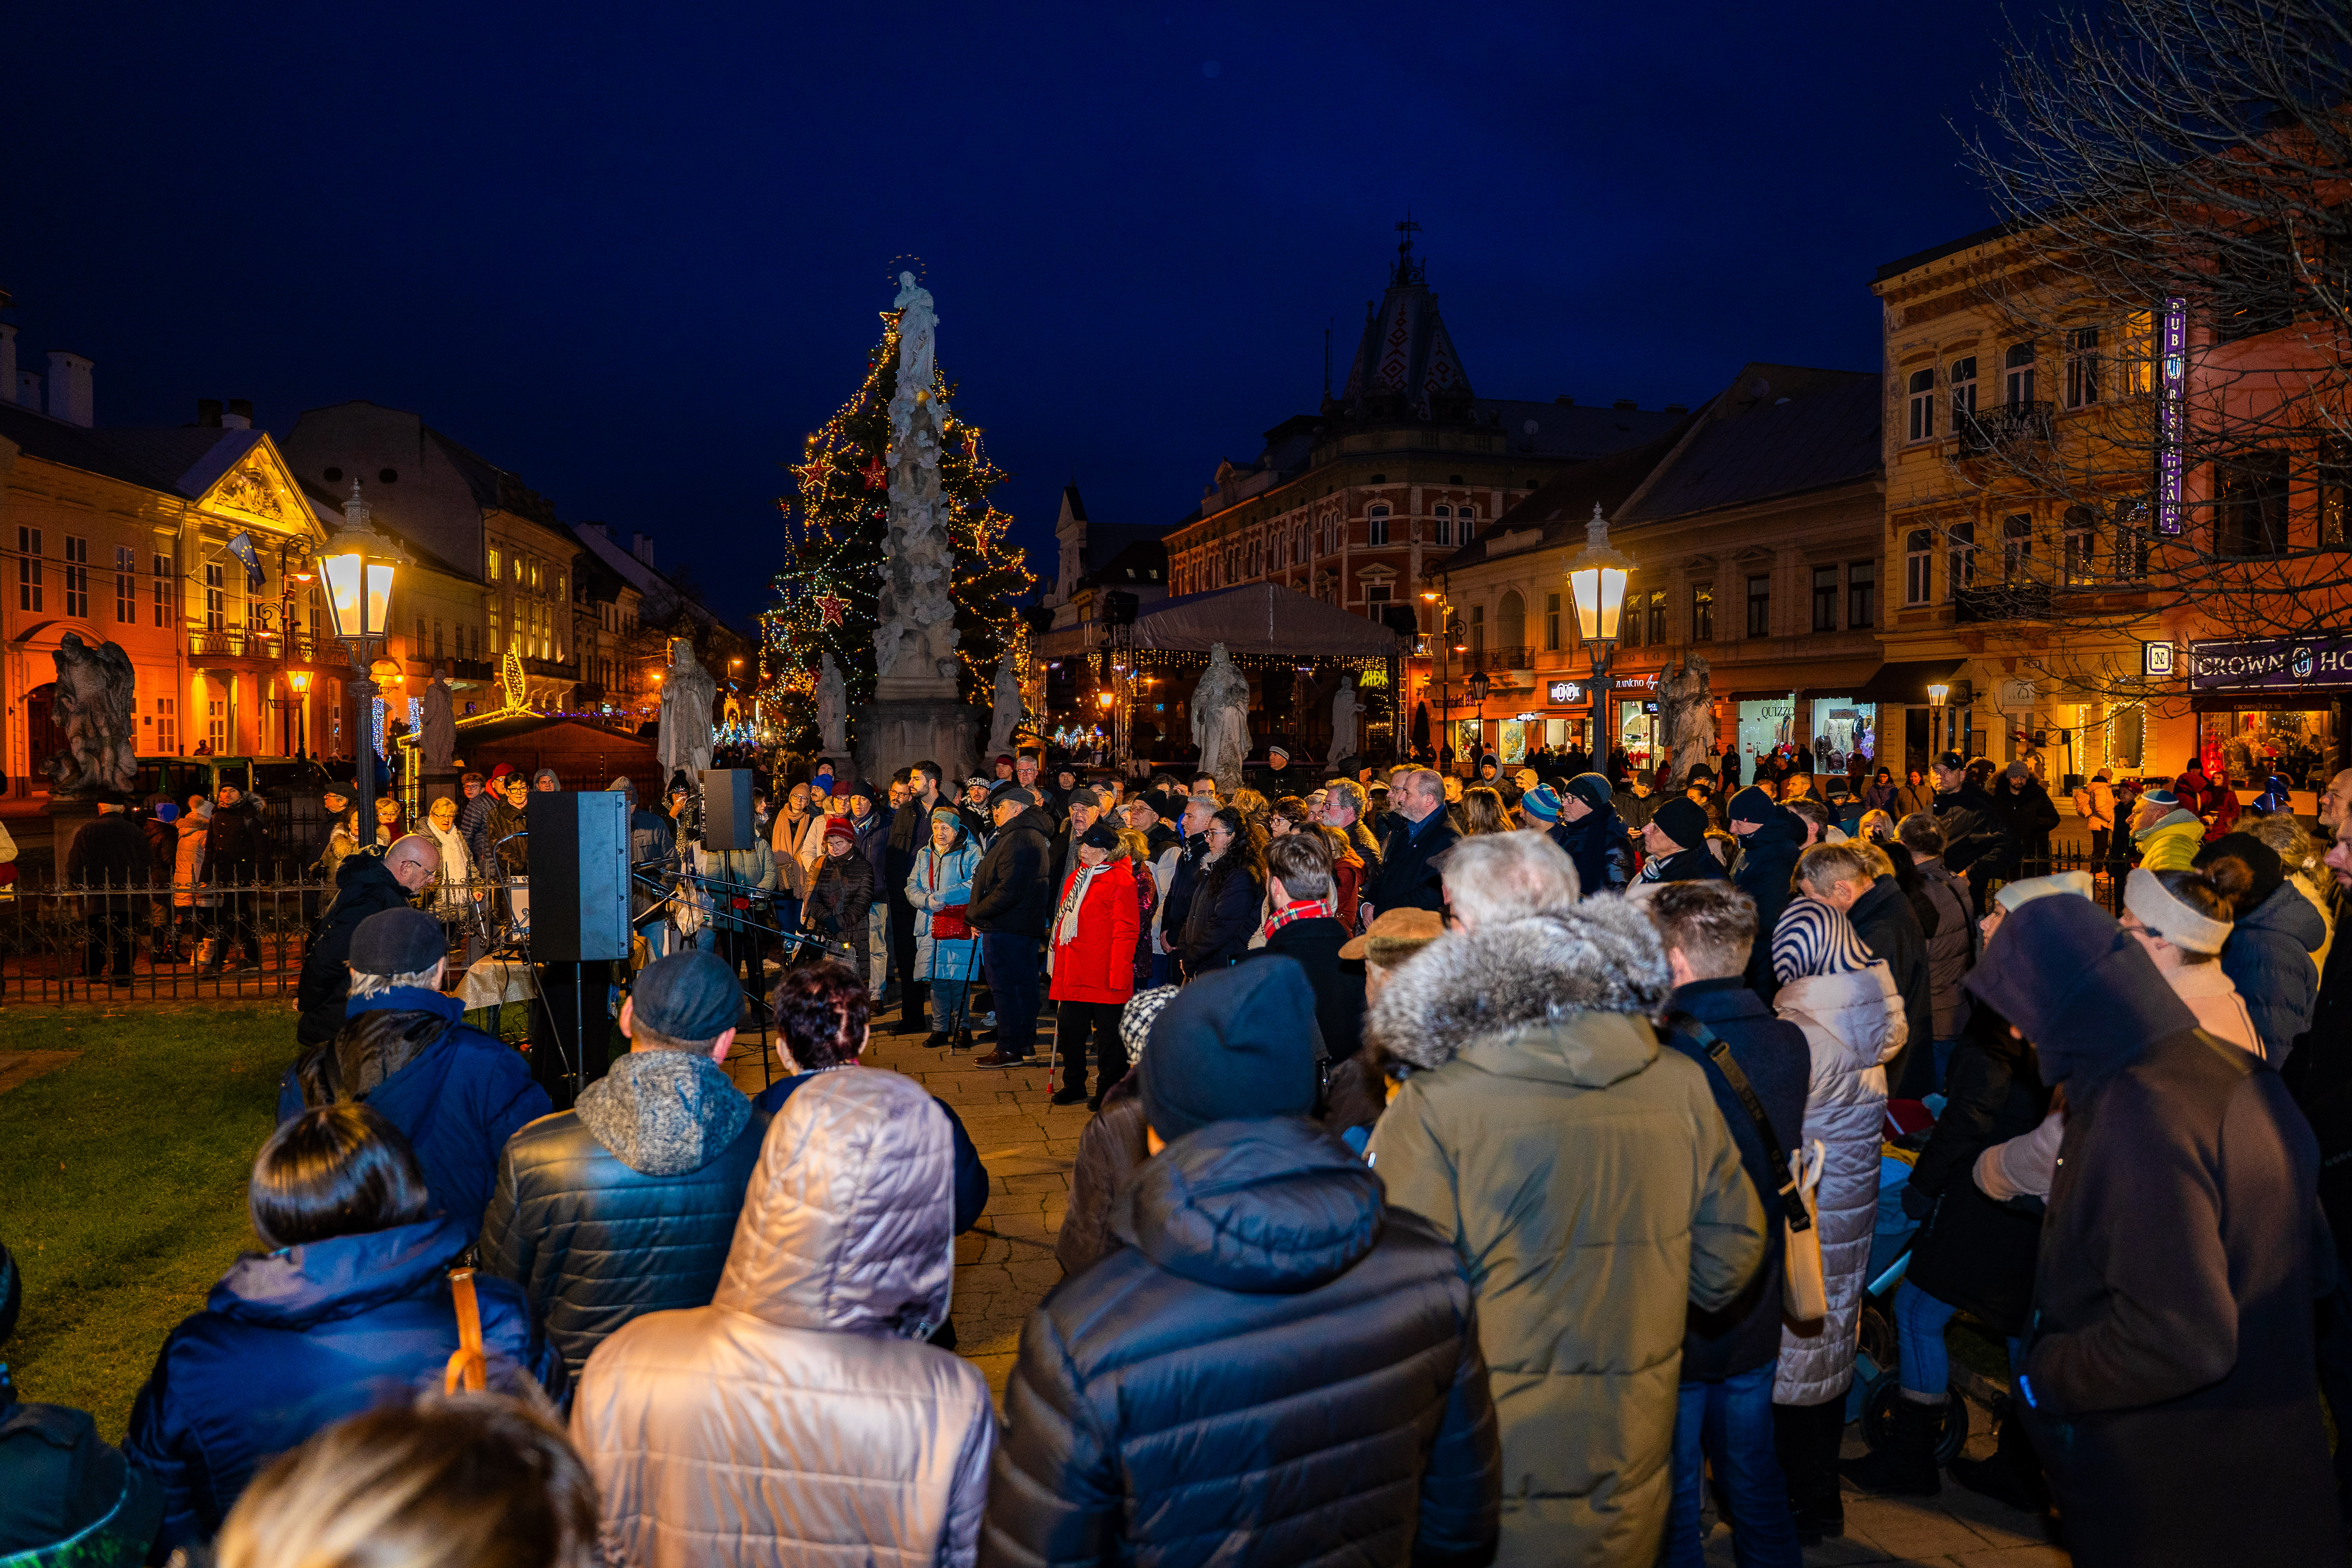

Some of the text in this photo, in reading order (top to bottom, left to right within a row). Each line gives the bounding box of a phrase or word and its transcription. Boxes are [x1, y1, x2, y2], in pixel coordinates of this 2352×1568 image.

[2171, 302, 2180, 346] PUB
[2198, 653, 2285, 676] CROWN
[1359, 670, 1388, 686] AIDA
[2017, 683, 2029, 699] 75
[1762, 706, 1794, 719] QUIZZO
